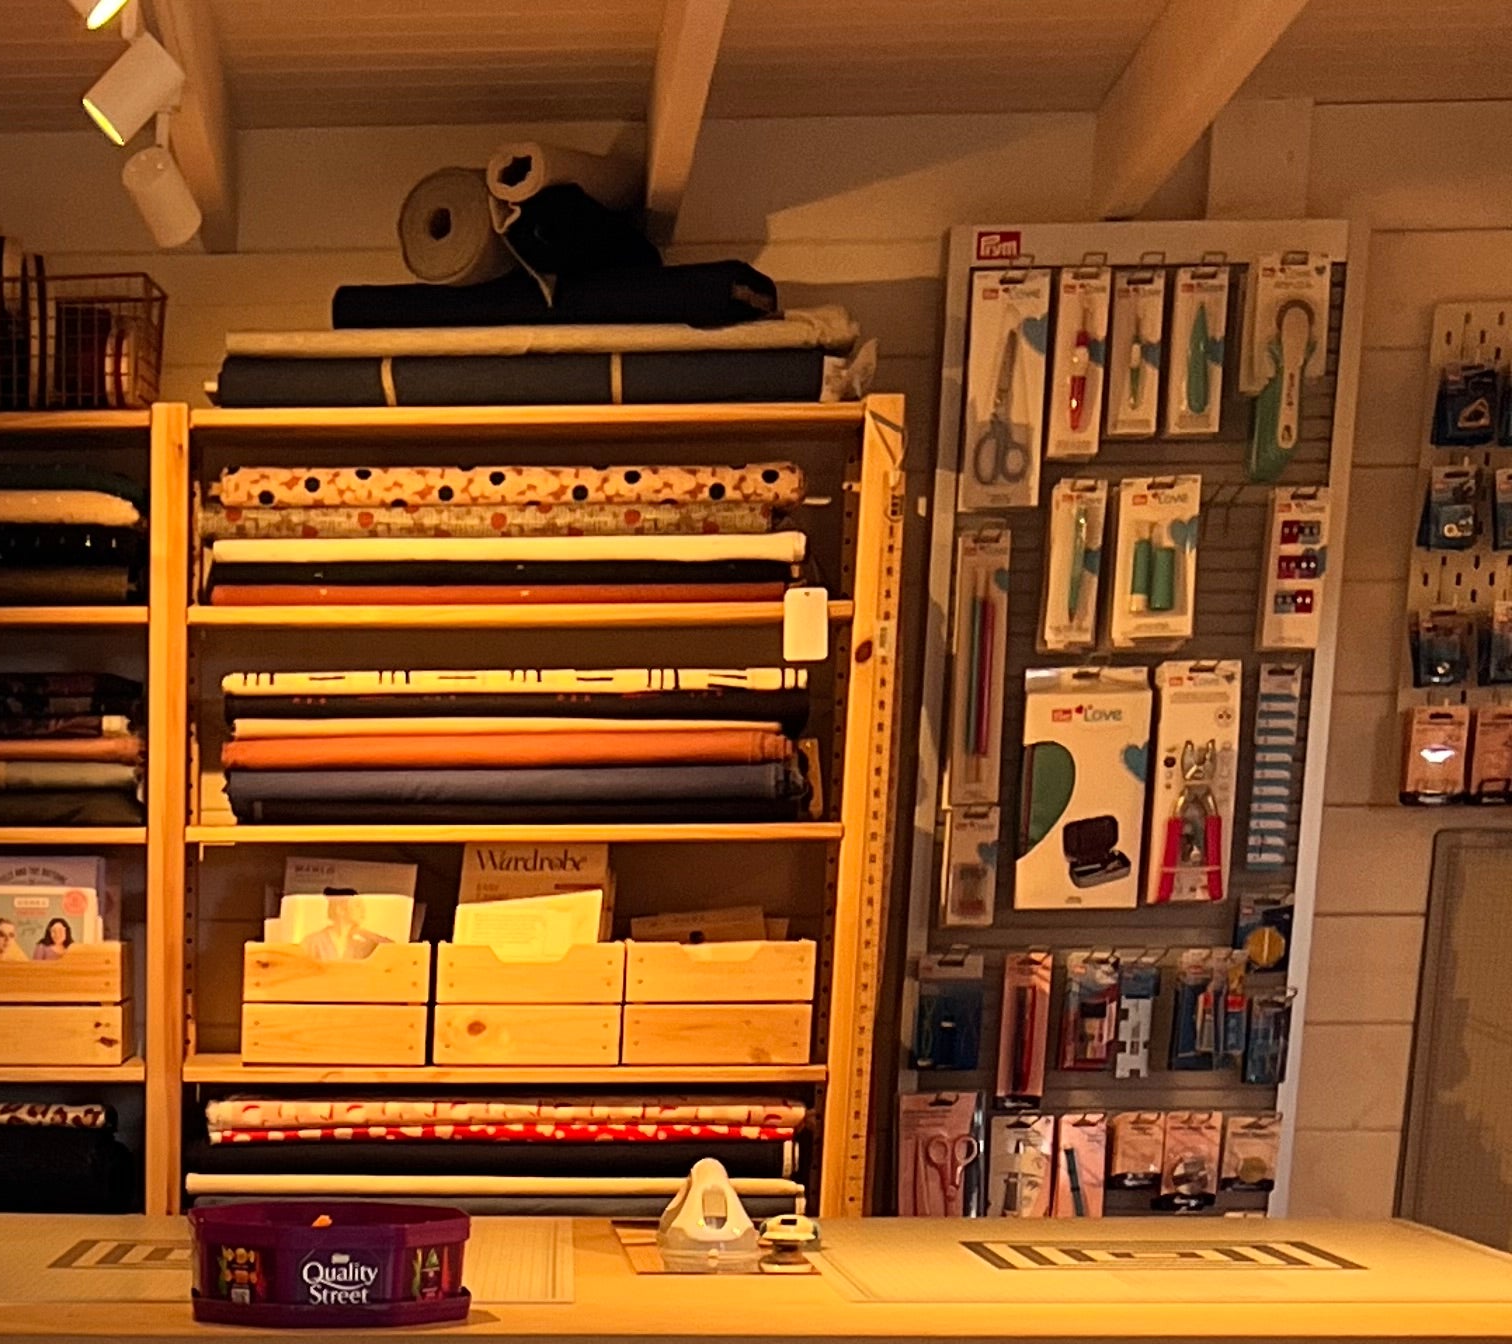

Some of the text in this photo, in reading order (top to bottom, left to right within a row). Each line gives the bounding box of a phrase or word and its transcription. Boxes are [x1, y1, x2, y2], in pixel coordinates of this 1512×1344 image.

[979, 234, 1018, 257] Prym
[1083, 705, 1122, 722] Love
[302, 1261, 378, 1289] Quality
[309, 1285, 369, 1304] Street
